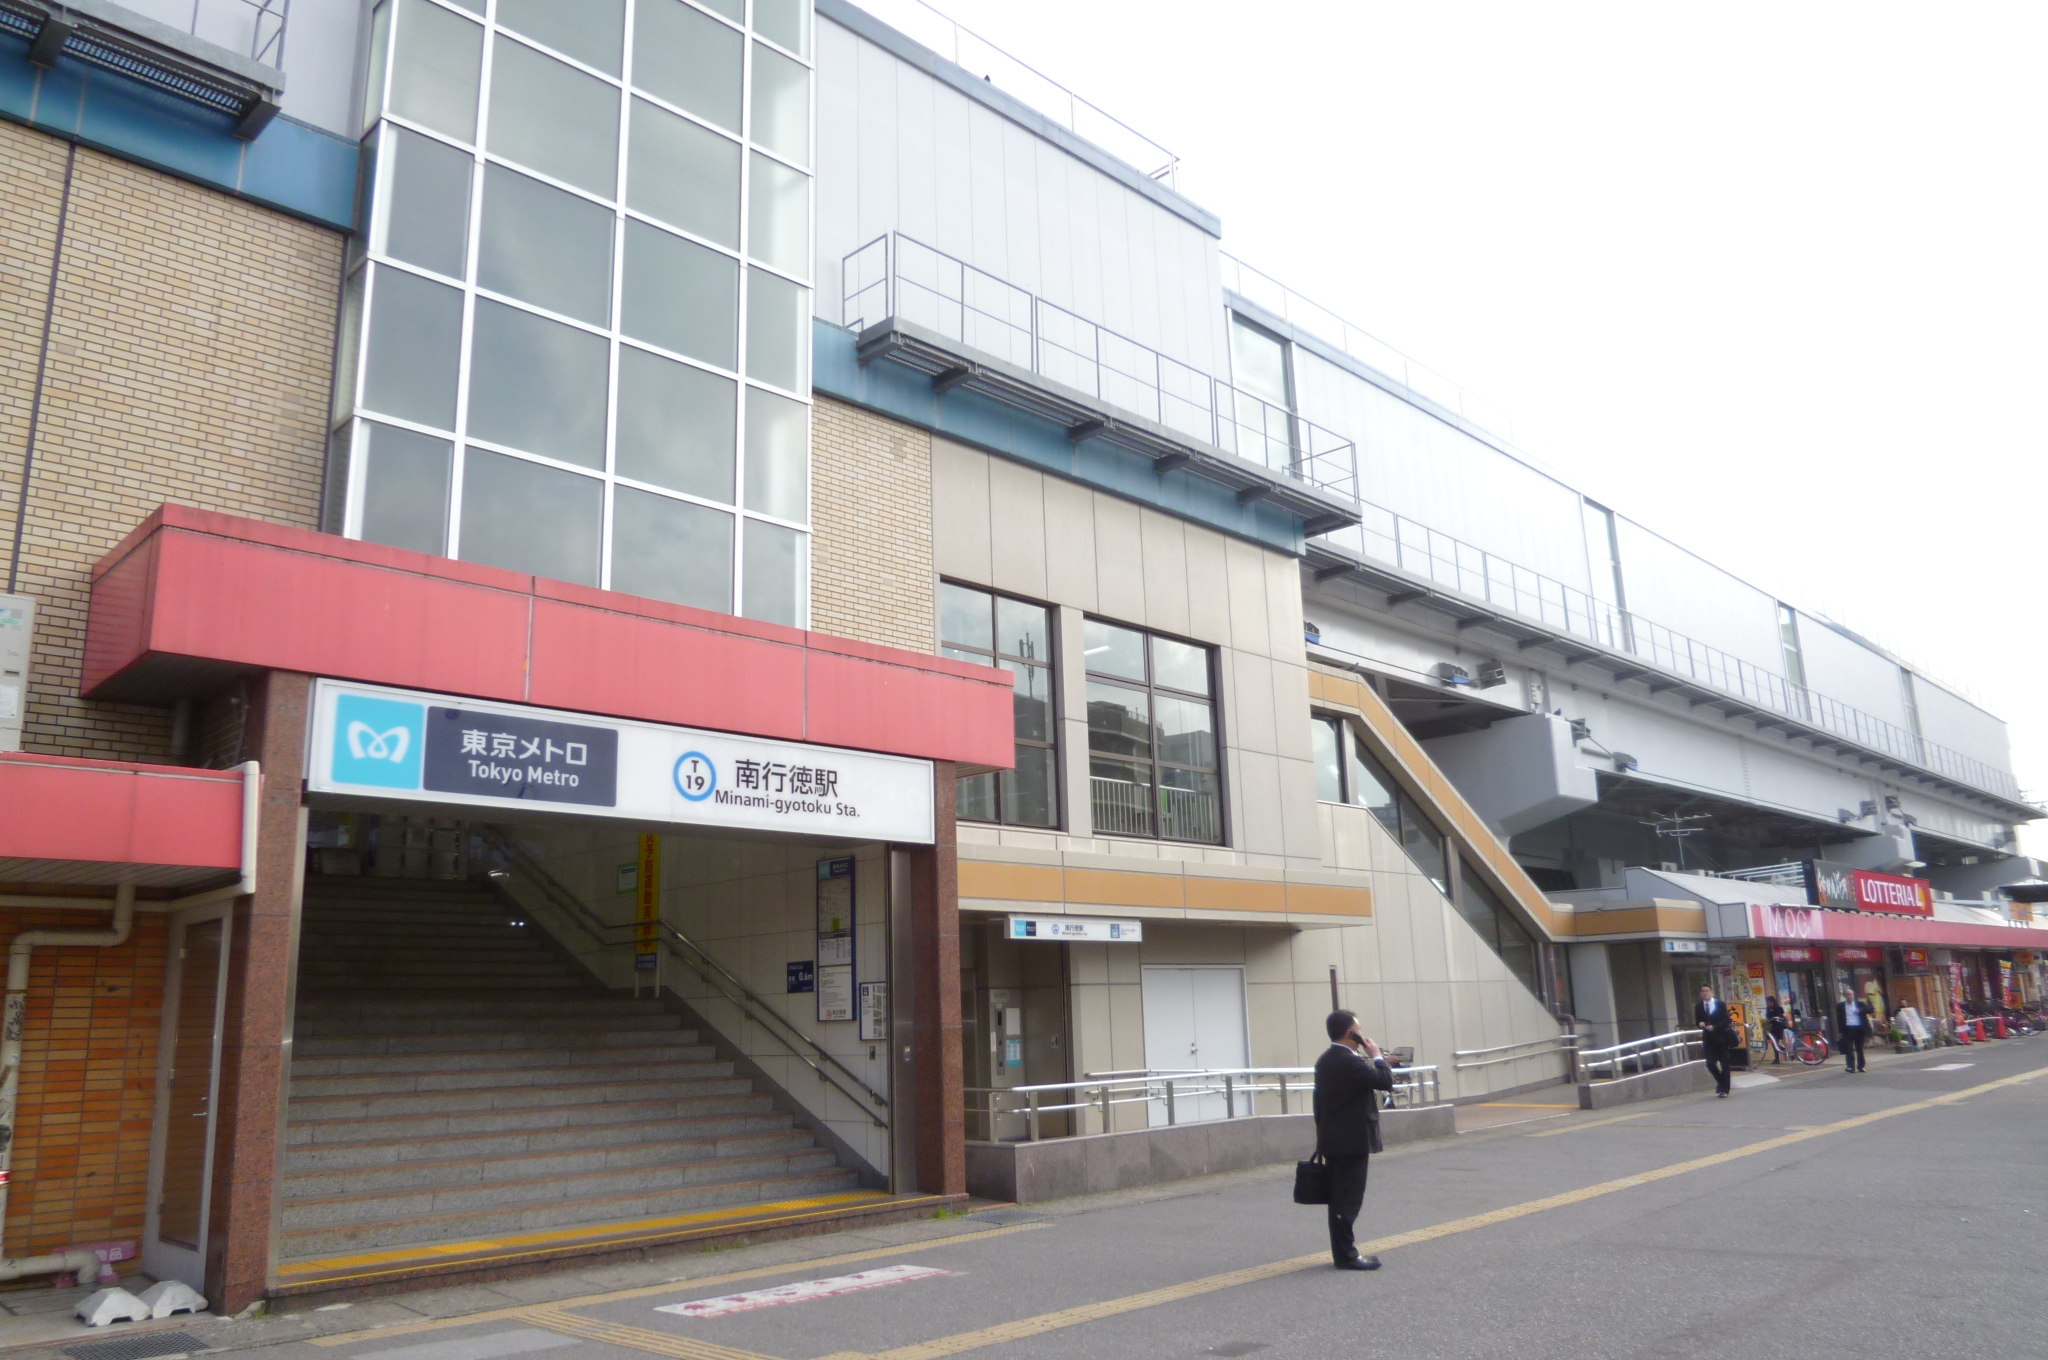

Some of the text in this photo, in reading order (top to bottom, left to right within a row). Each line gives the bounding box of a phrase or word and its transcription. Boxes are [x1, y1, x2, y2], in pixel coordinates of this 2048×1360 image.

[461, 729, 588, 766] 東京メトロ
[468, 759, 579, 787] Tokyo Metro
[691, 759, 699, 773] T
[735, 758, 838, 798] 南行徳駅
[686, 775, 705, 790] 19
[715, 789, 860, 817] Minami-gyotoku Sta.
[1860, 878, 1914, 906] LOTTERIA
